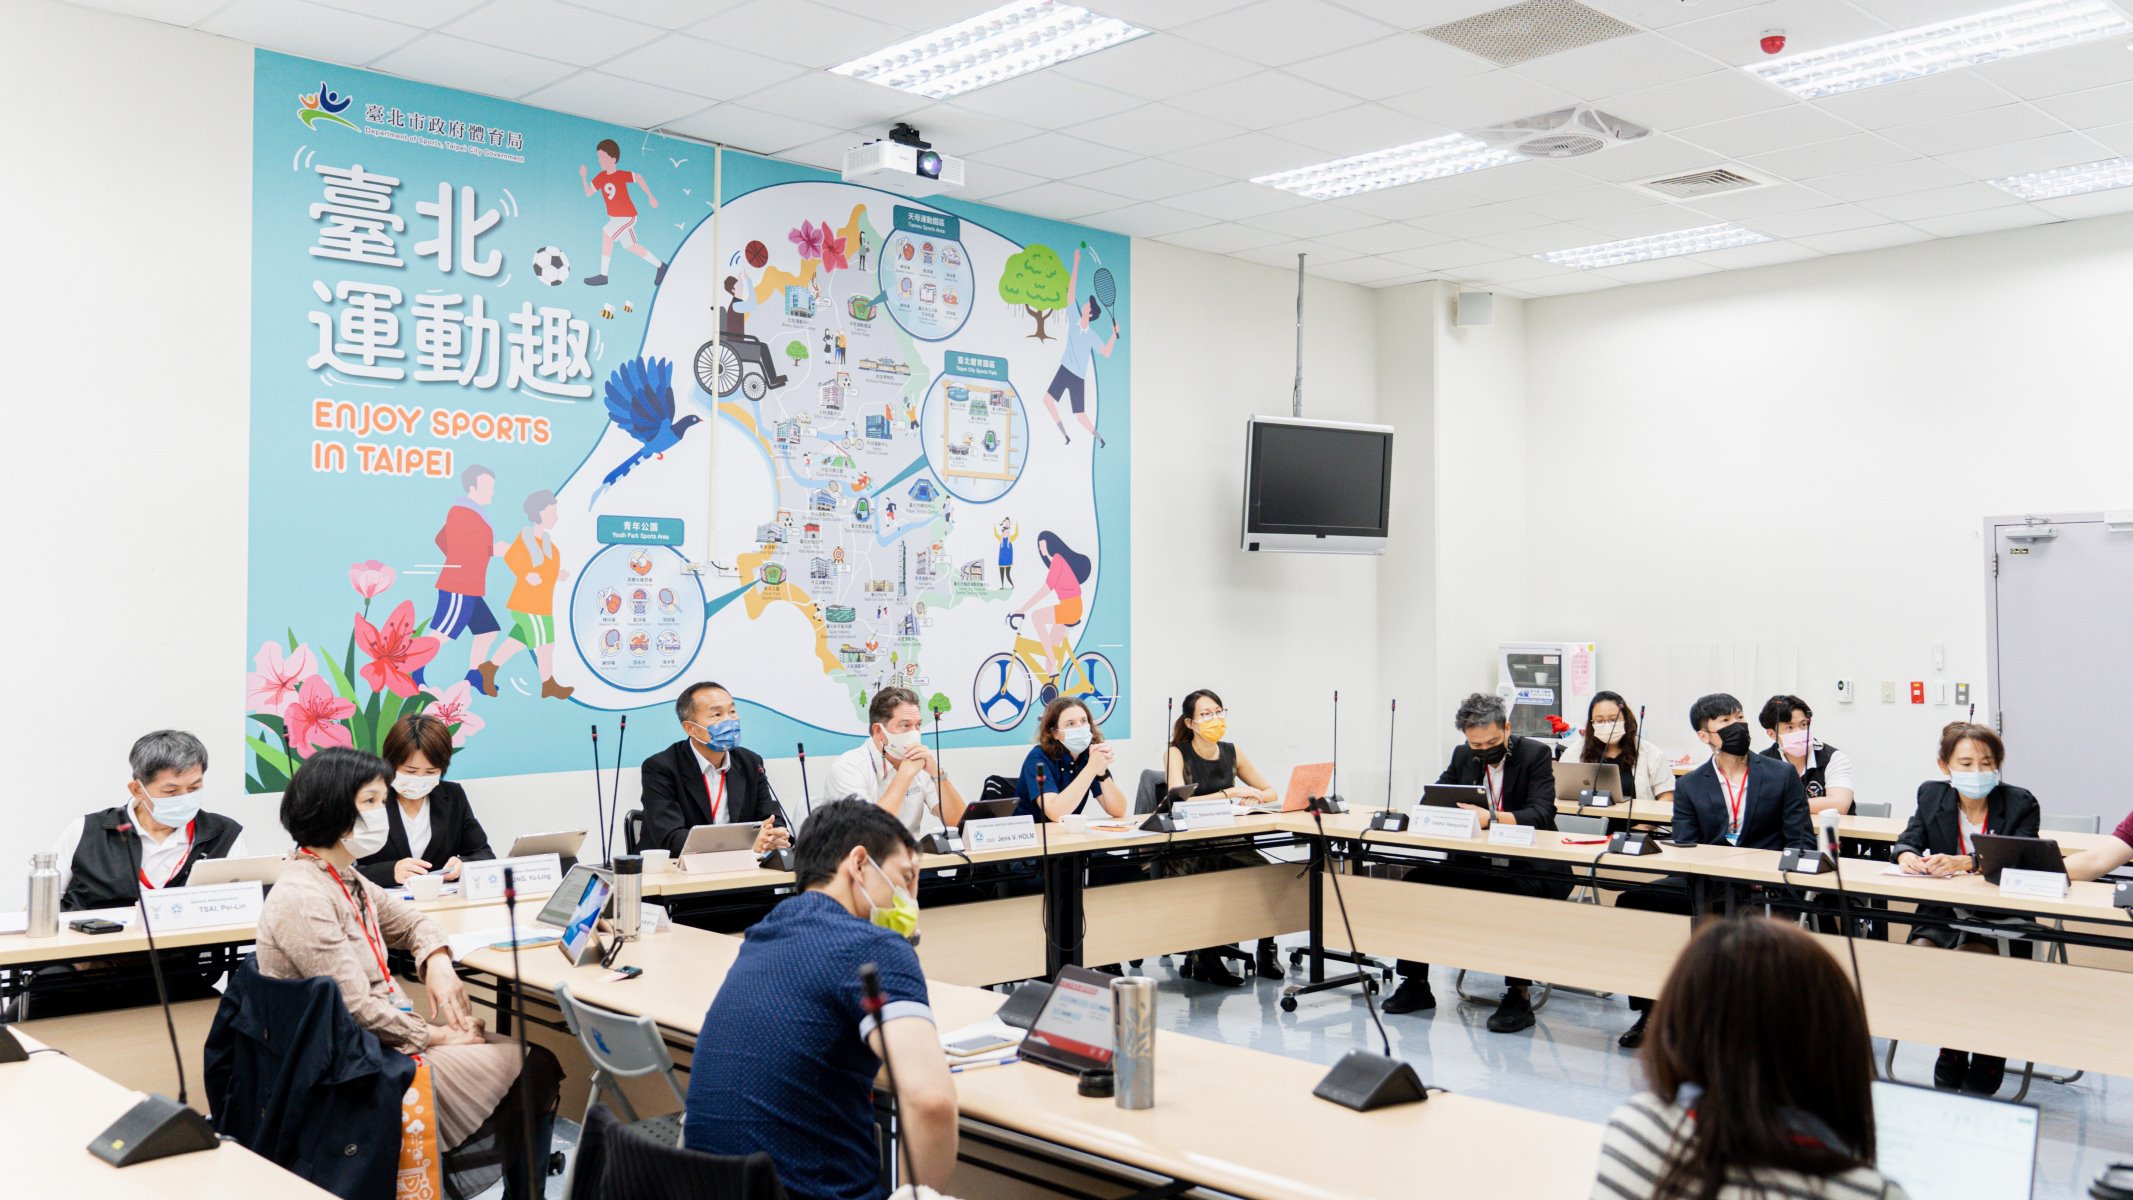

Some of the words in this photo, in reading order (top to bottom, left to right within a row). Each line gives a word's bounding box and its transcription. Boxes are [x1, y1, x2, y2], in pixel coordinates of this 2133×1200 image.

[365, 126, 408, 141] Department
[409, 135, 417, 143] of
[446, 142, 467, 153] Taipei
[468, 146, 482, 156] City
[484, 149, 525, 163] Government
[366, 104, 523, 150] 臺北市政府體育局
[604, 182, 616, 200] 9
[308, 163, 503, 278] 臺北
[307, 279, 593, 398] 運動趣
[314, 400, 421, 437] ENJOY
[432, 409, 550, 443] SPORTS
[315, 442, 345, 470] IN
[356, 445, 452, 476] TAIPEI
[623, 521, 659, 532] 青年公園
